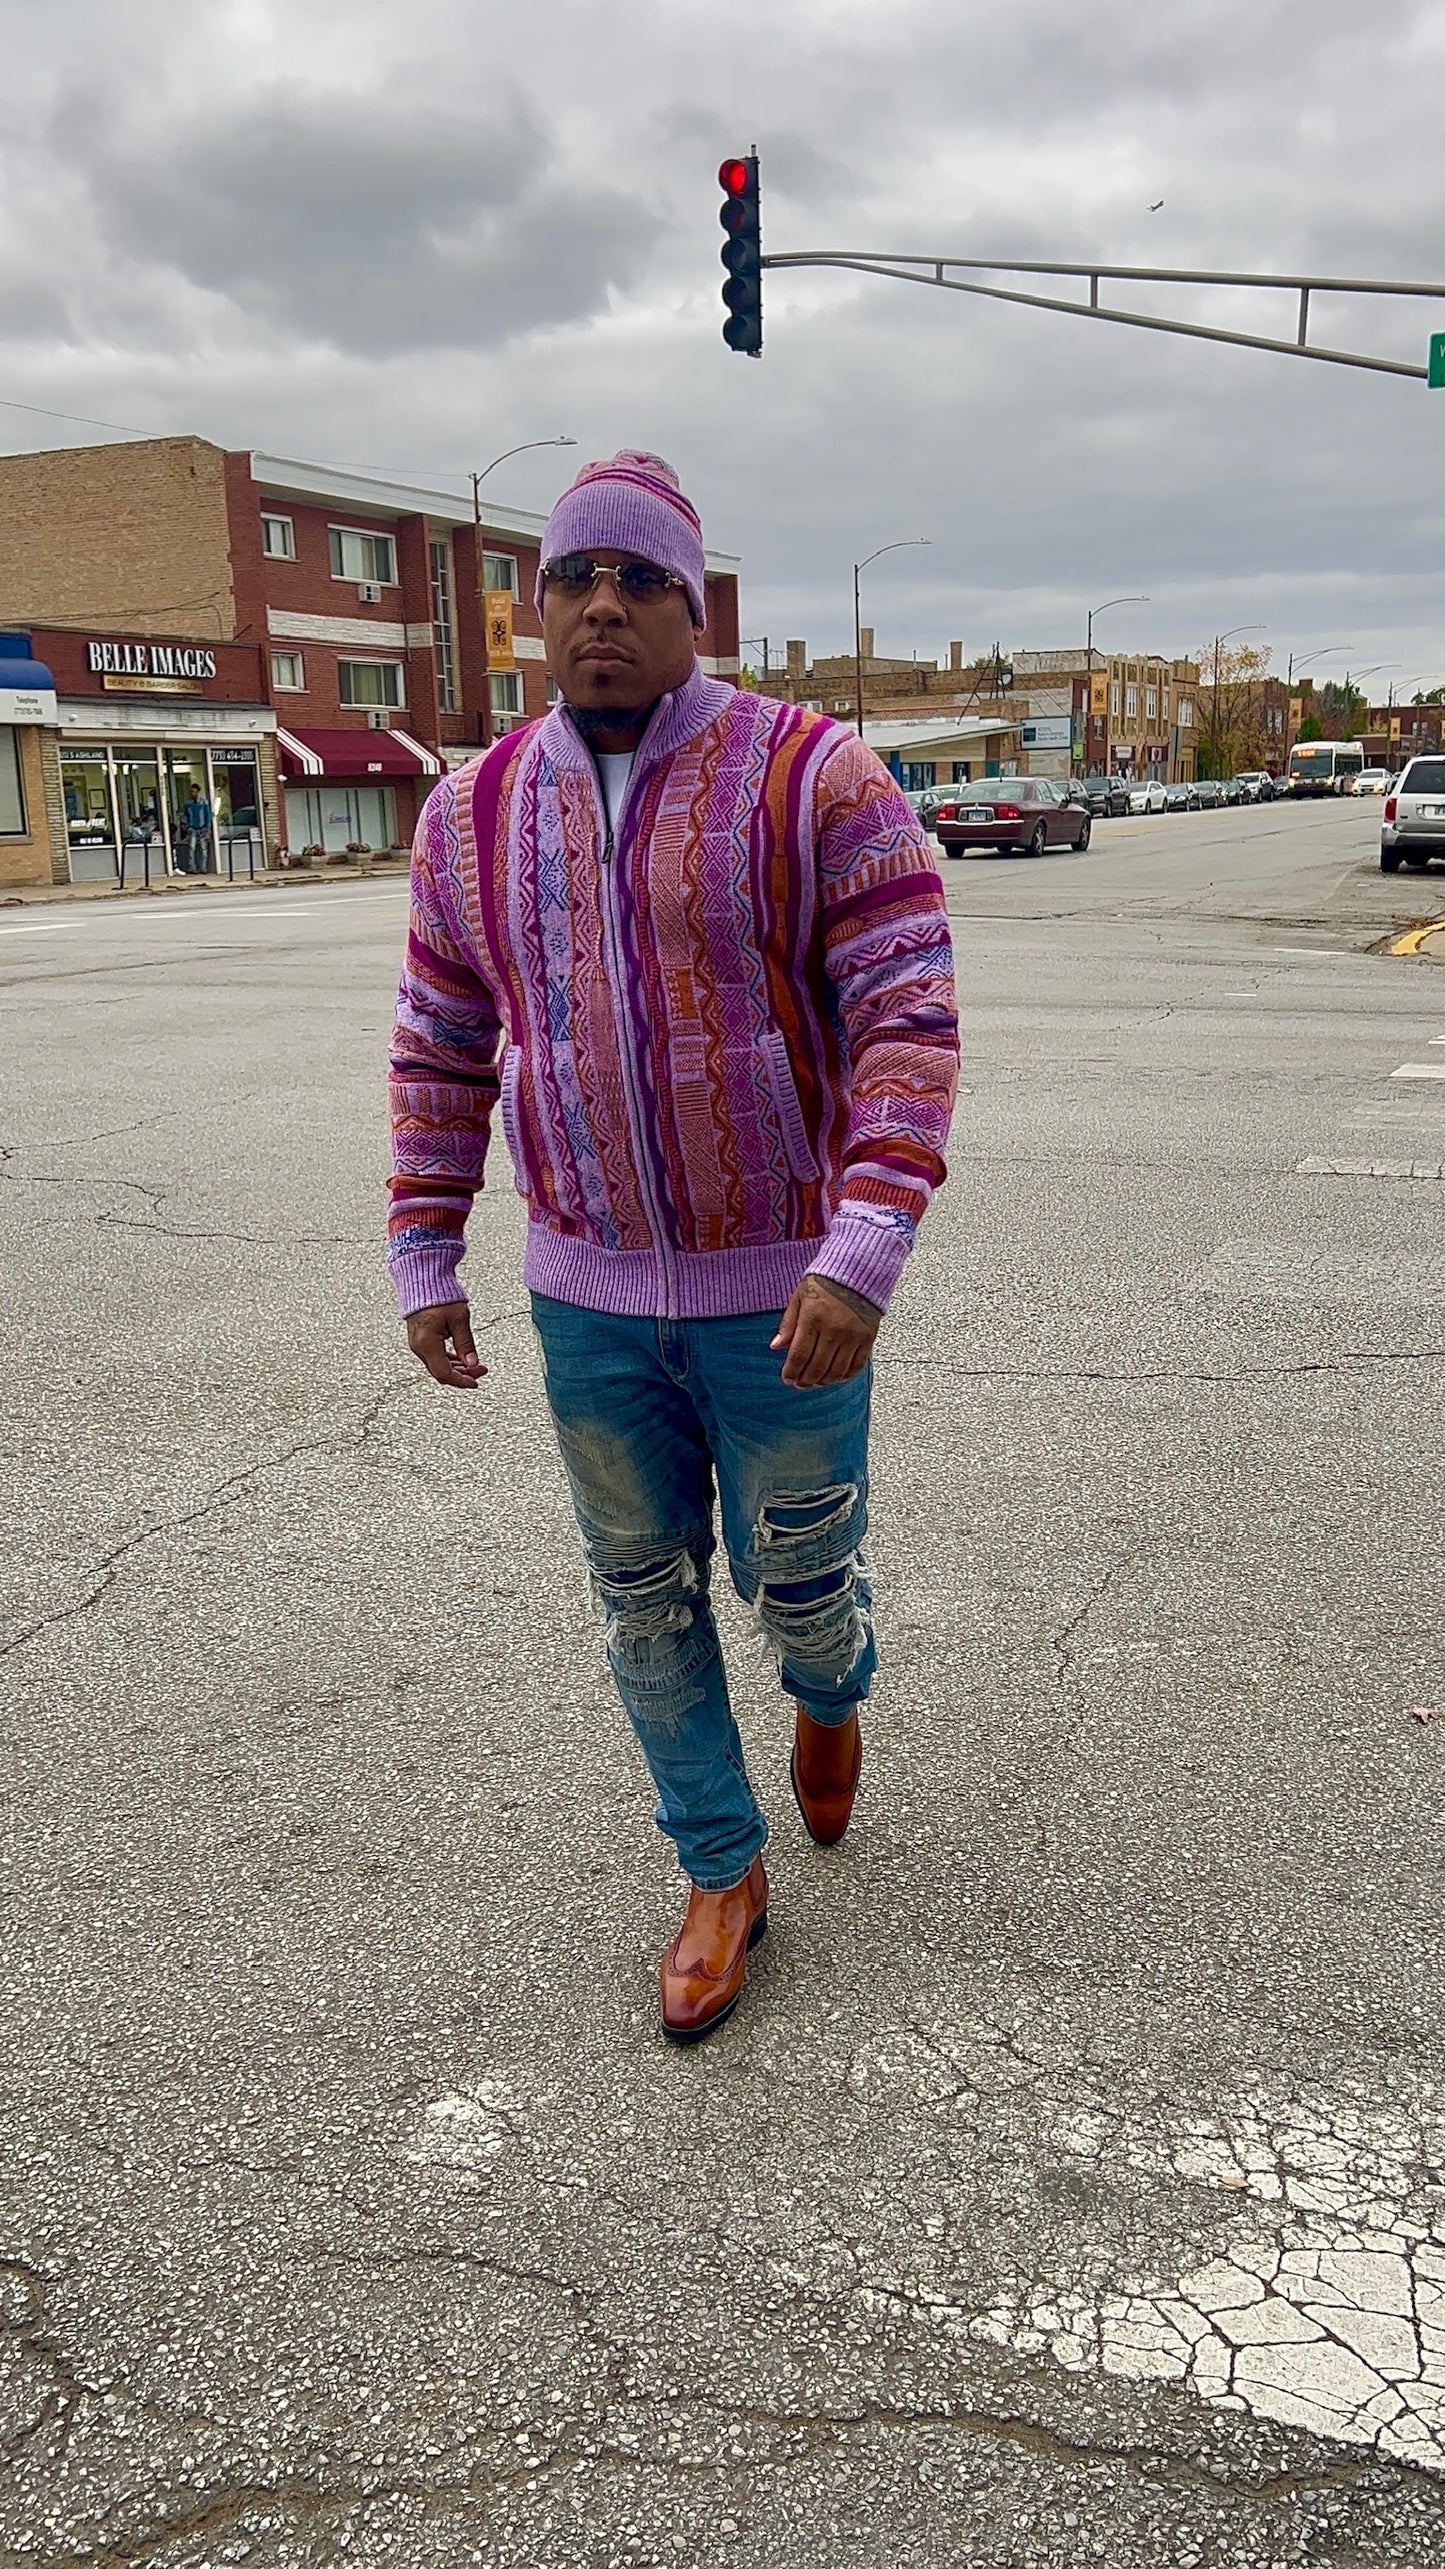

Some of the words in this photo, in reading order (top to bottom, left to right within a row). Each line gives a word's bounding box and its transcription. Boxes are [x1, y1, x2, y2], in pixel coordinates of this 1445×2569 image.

[88, 641, 148, 673] BELLE
[150, 646, 216, 678] IMAGES
[107, 678, 137, 687] BEAUTY
[147, 681, 175, 690] BARBER
